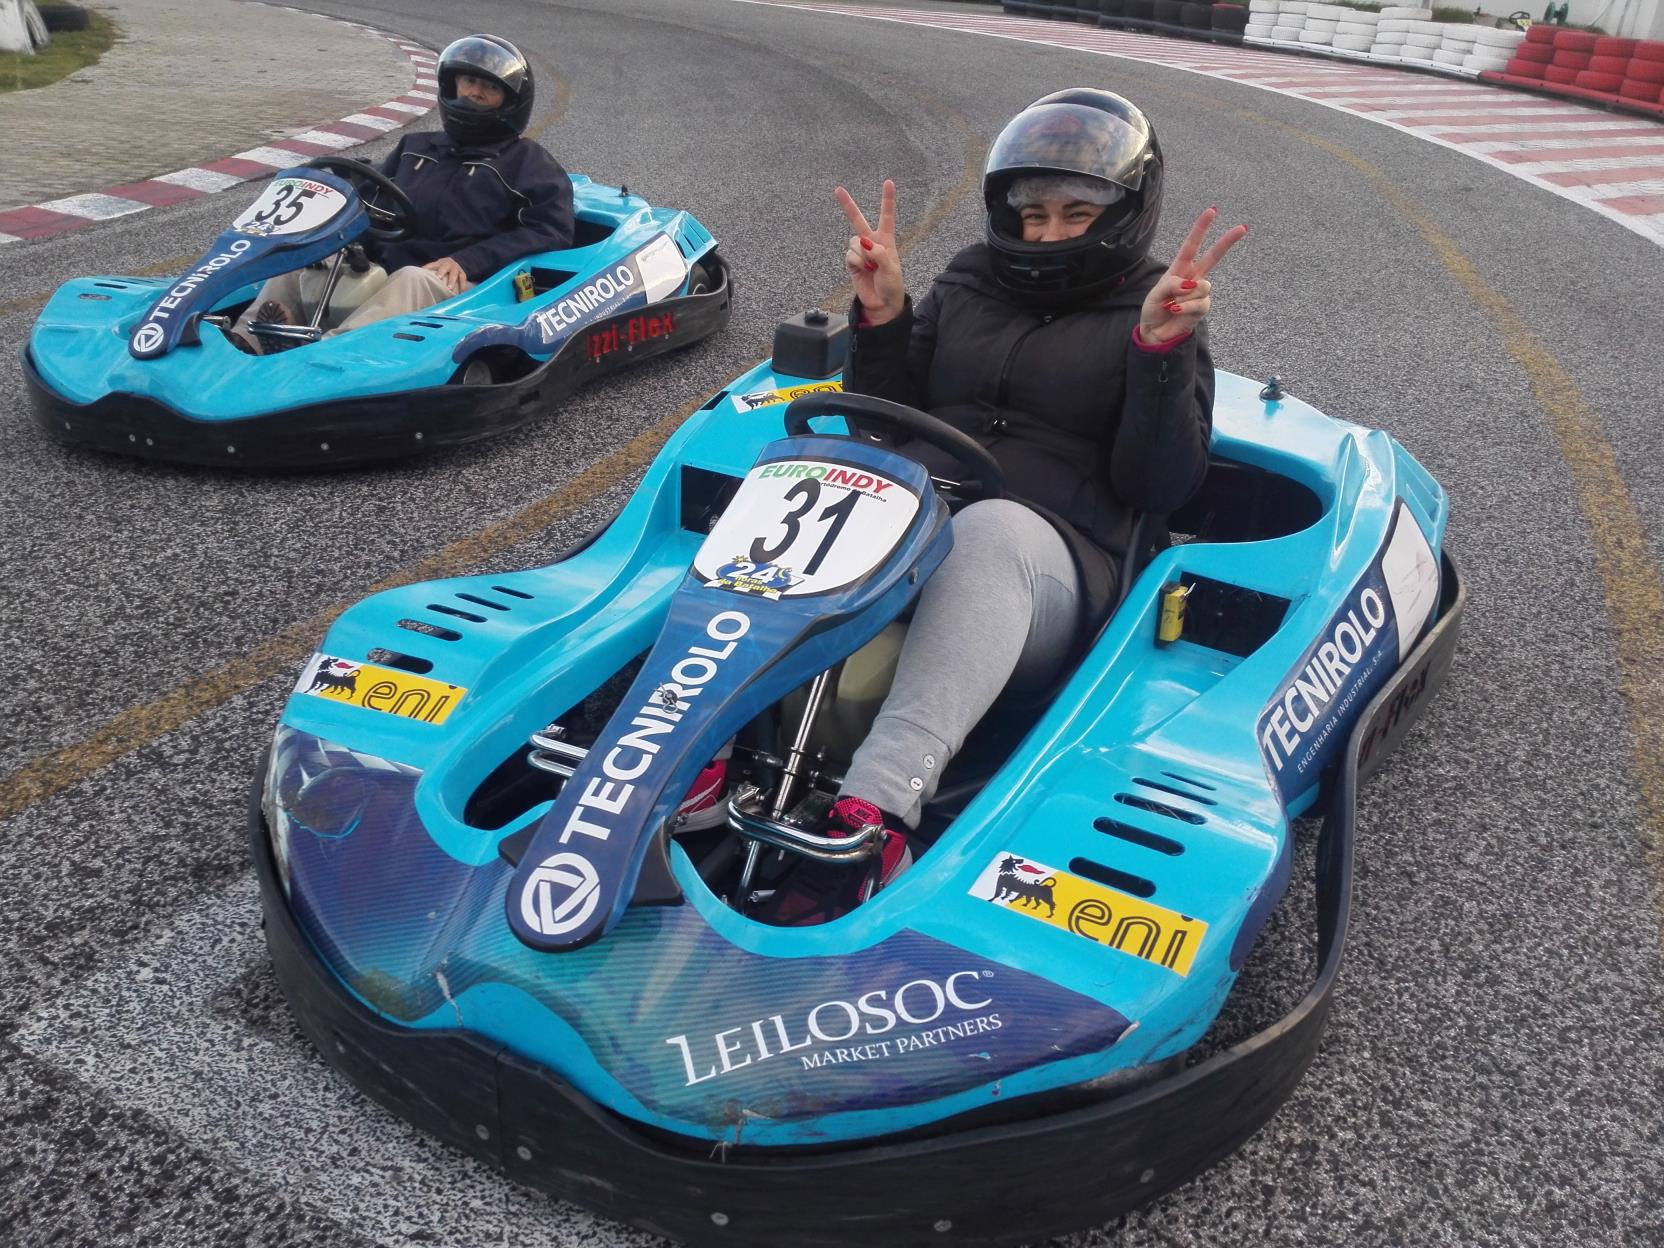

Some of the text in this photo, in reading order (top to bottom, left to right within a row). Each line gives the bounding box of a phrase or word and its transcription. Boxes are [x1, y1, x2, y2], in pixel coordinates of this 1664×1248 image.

[255, 184, 317, 226] 35
[149, 239, 251, 320] TECNIROLO
[536, 265, 635, 337] TECNIROLO
[758, 464, 893, 494] EUROINDY
[749, 477, 861, 576] 31
[726, 561, 779, 584] 24
[362, 681, 458, 723] eni
[1262, 587, 1385, 772] TECNIROLO
[559, 610, 751, 844] TECNIROLO
[1297, 715, 1338, 774] ENGENHARIA
[1067, 898, 1194, 970] eni
[801, 1013, 1002, 1070] MARKET PARTNERS
